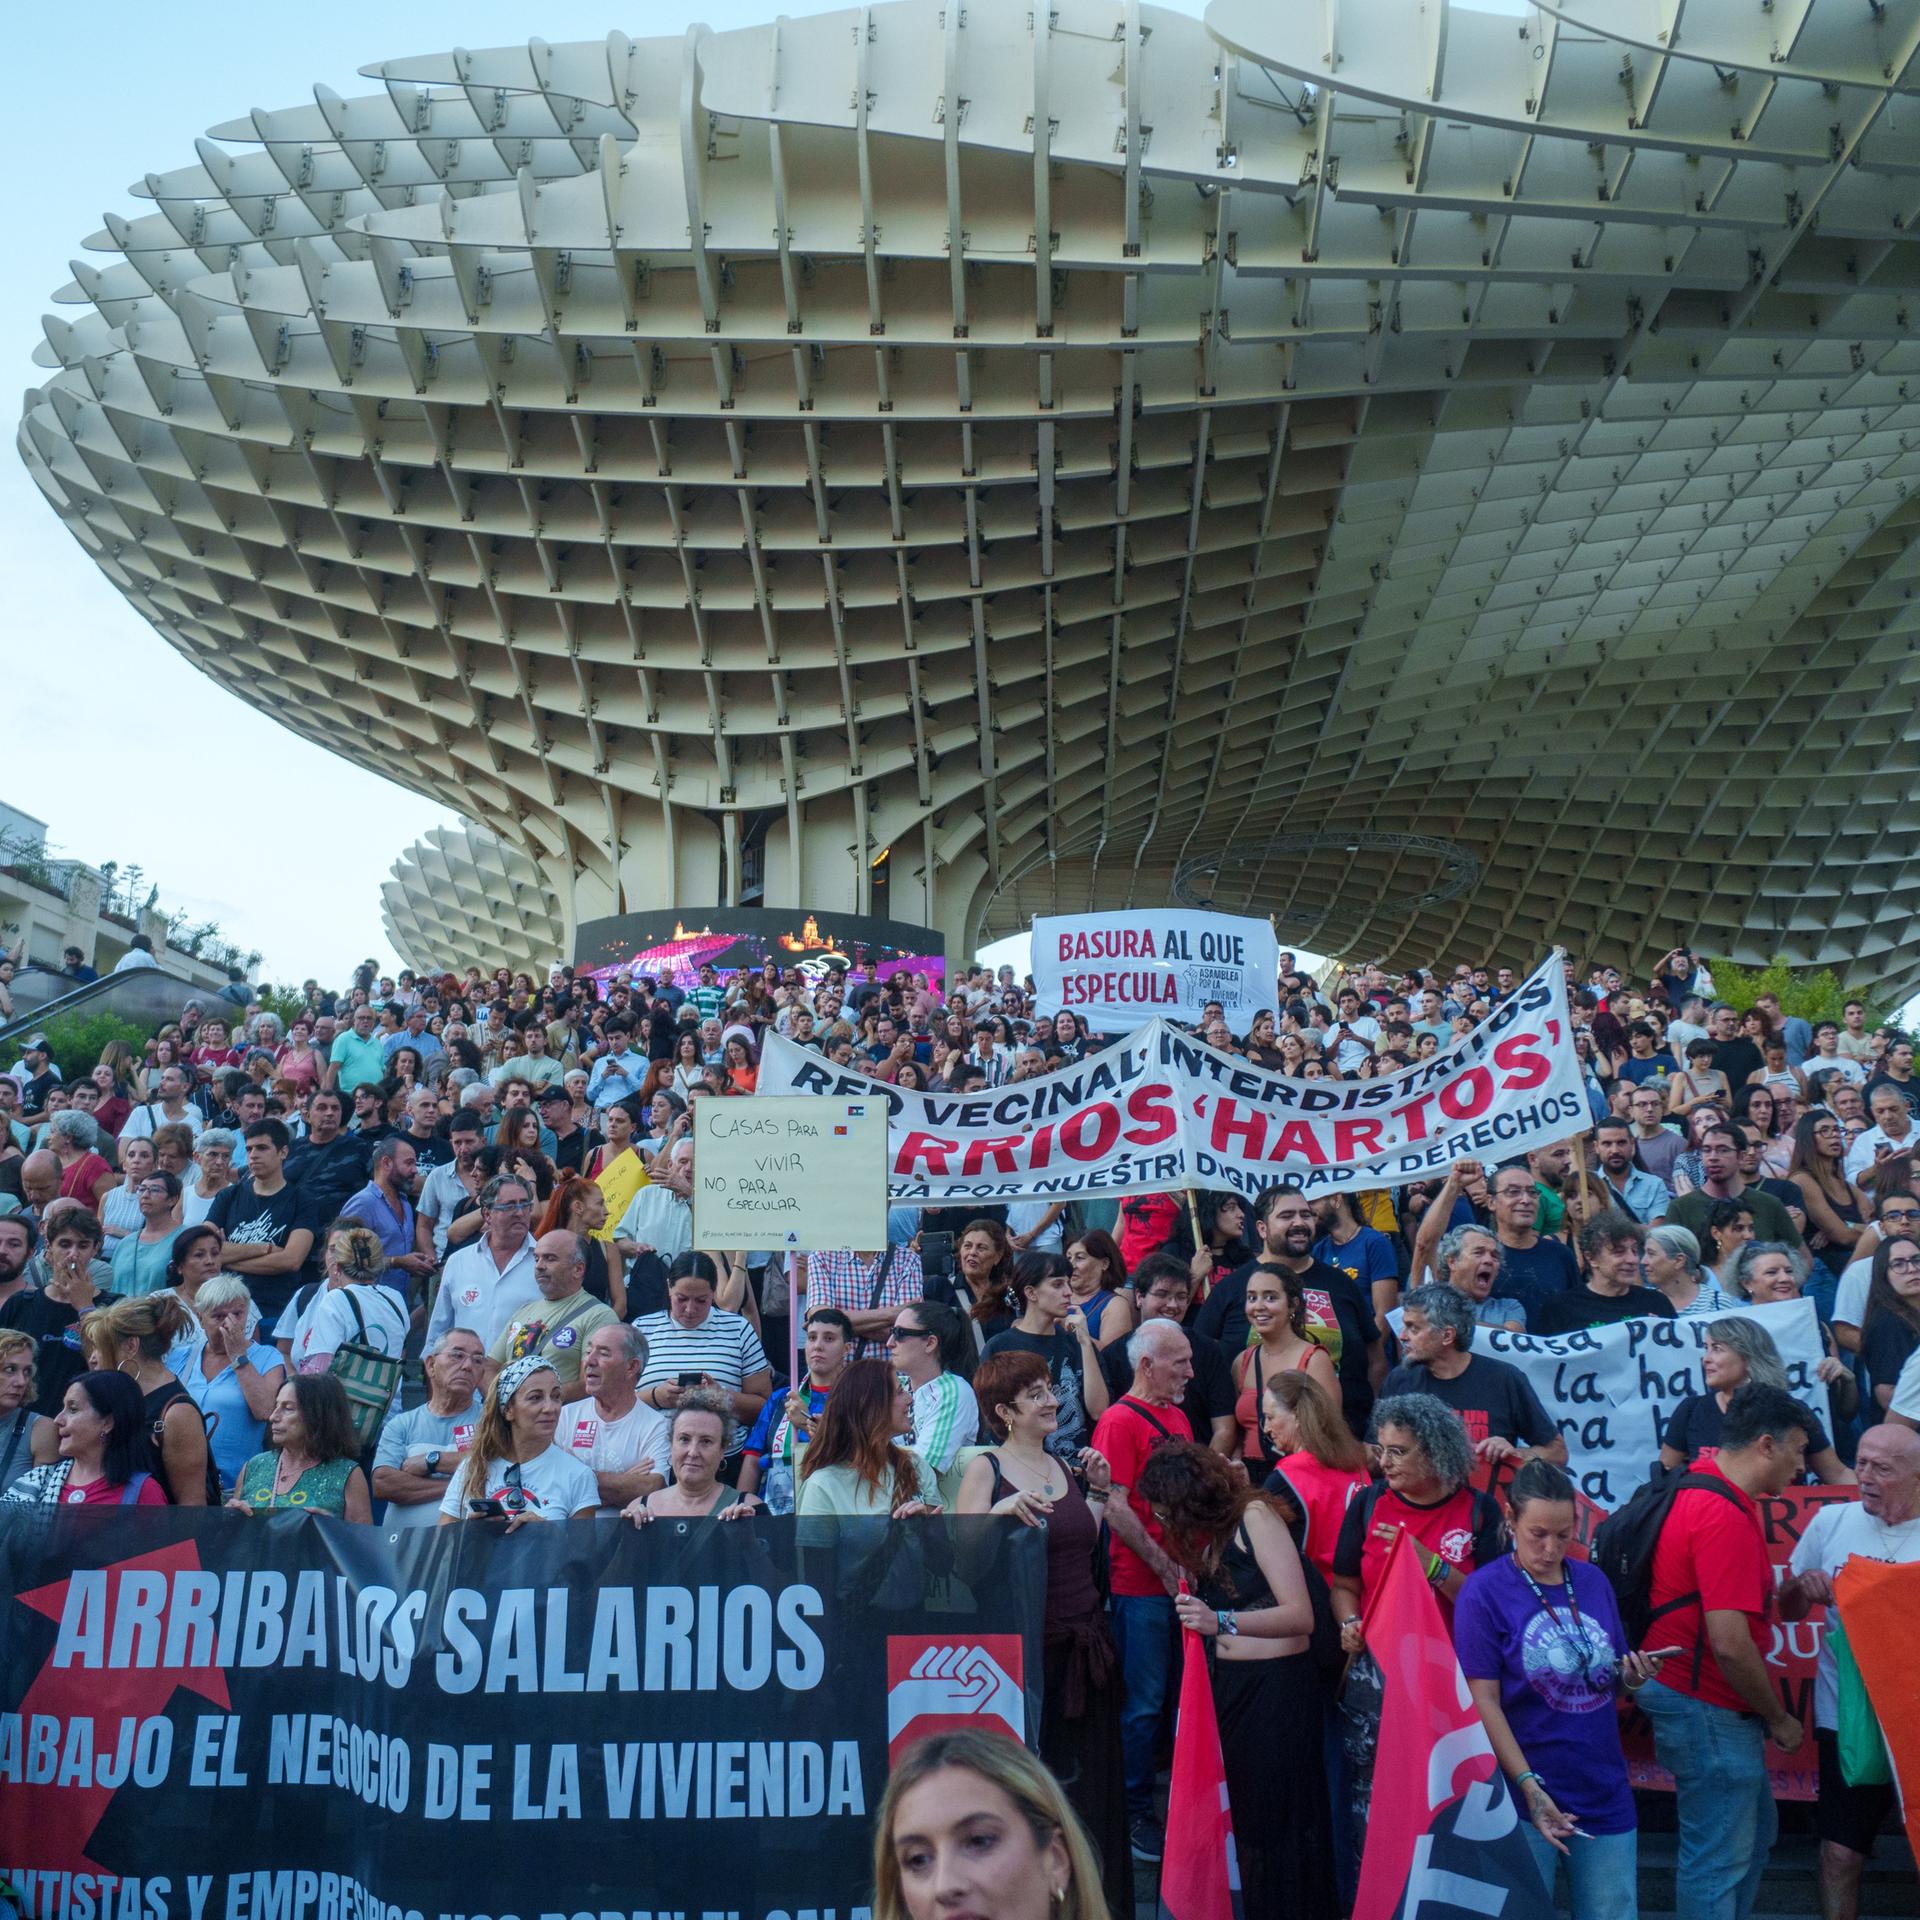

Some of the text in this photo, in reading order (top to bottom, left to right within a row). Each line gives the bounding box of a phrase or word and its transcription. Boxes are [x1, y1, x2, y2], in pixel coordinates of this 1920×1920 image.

[1059, 929, 1244, 965] BASURA AL QUE
[1062, 972, 1178, 1005] ESPECULA
[1199, 968, 1239, 981] ASAMBLEA
[1212, 980, 1220, 989] LA
[923, 1049, 1147, 1127] VECINAL
[894, 1083, 1177, 1176] RRIOS
[944, 1182, 1025, 1197] POR
[1367, 1161, 1389, 1176] Y
[1400, 1091, 1582, 1172] DERECHOS
[704, 1176, 778, 1195] NO PARA
[727, 1197, 801, 1212] ESPECULAR
[1489, 1329, 1603, 1356] casa
[1553, 1361, 1605, 1404] la
[53, 1569, 825, 1694] ARRIBA LOS SALARIOS
[0, 1713, 865, 1821] ABAJO EL NEGOCIO DE LA VIVIENDA
